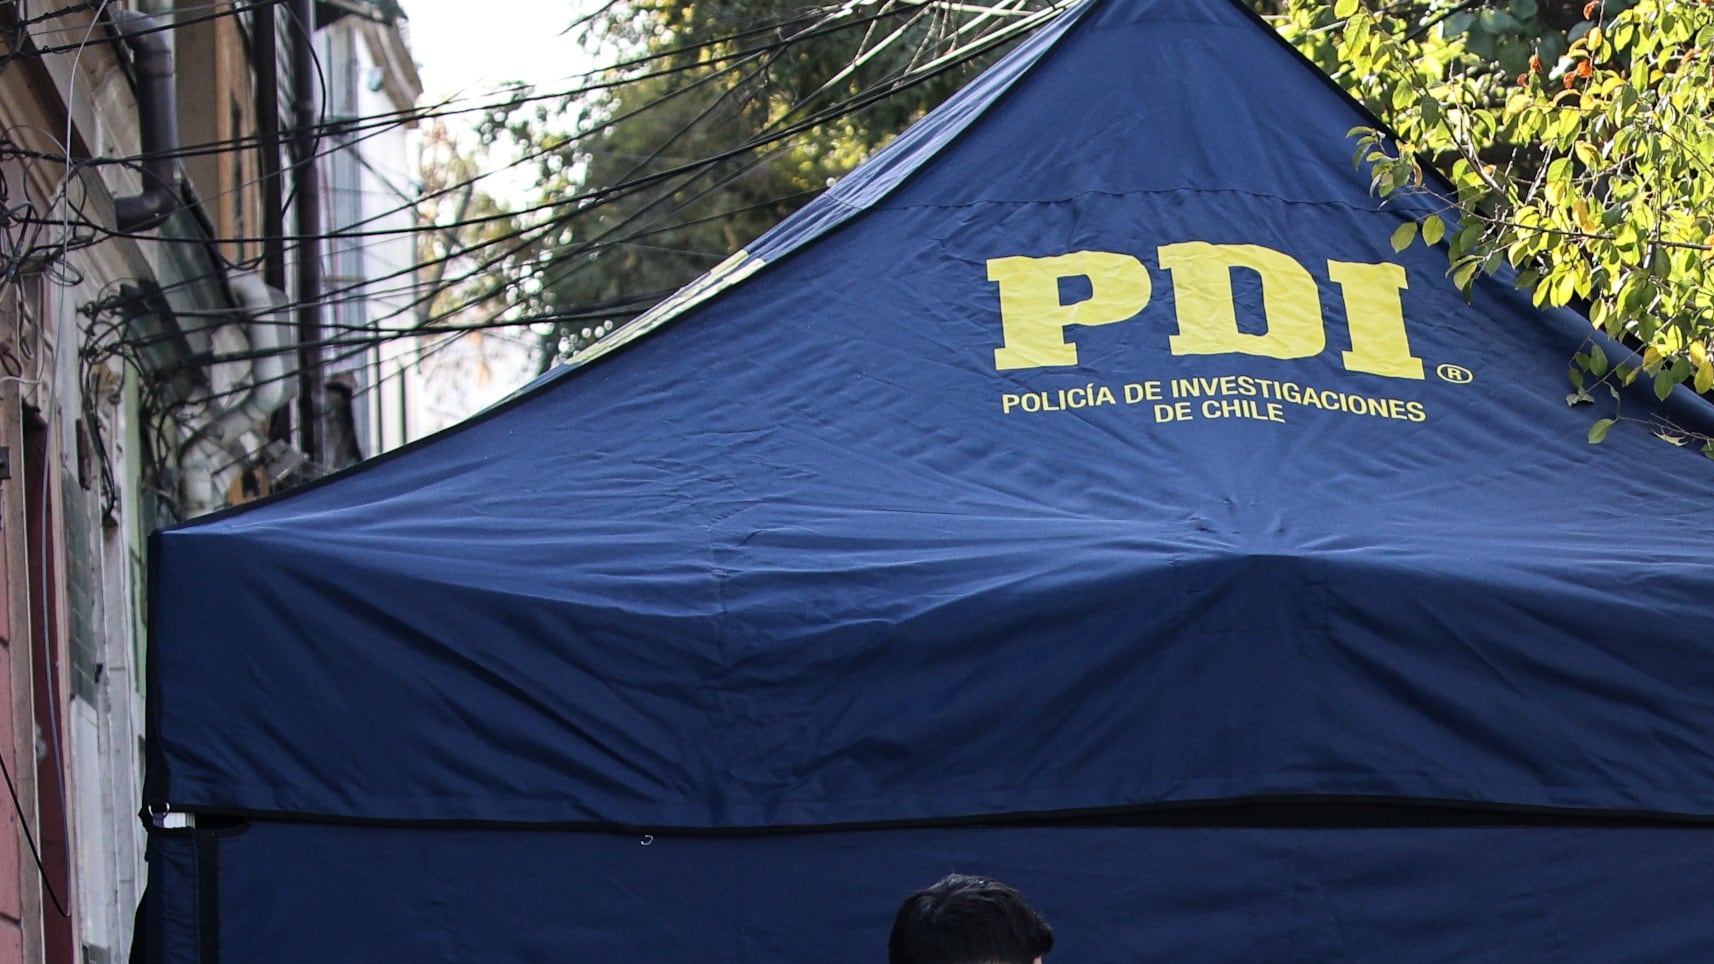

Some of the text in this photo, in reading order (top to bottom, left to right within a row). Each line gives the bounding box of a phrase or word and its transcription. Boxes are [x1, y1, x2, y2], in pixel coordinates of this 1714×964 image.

[986, 241, 1425, 380] PDI
[1002, 376, 1427, 422] POLICÍA DE INVESTIGACIONES
[1155, 400, 1286, 423] DE CHILE
